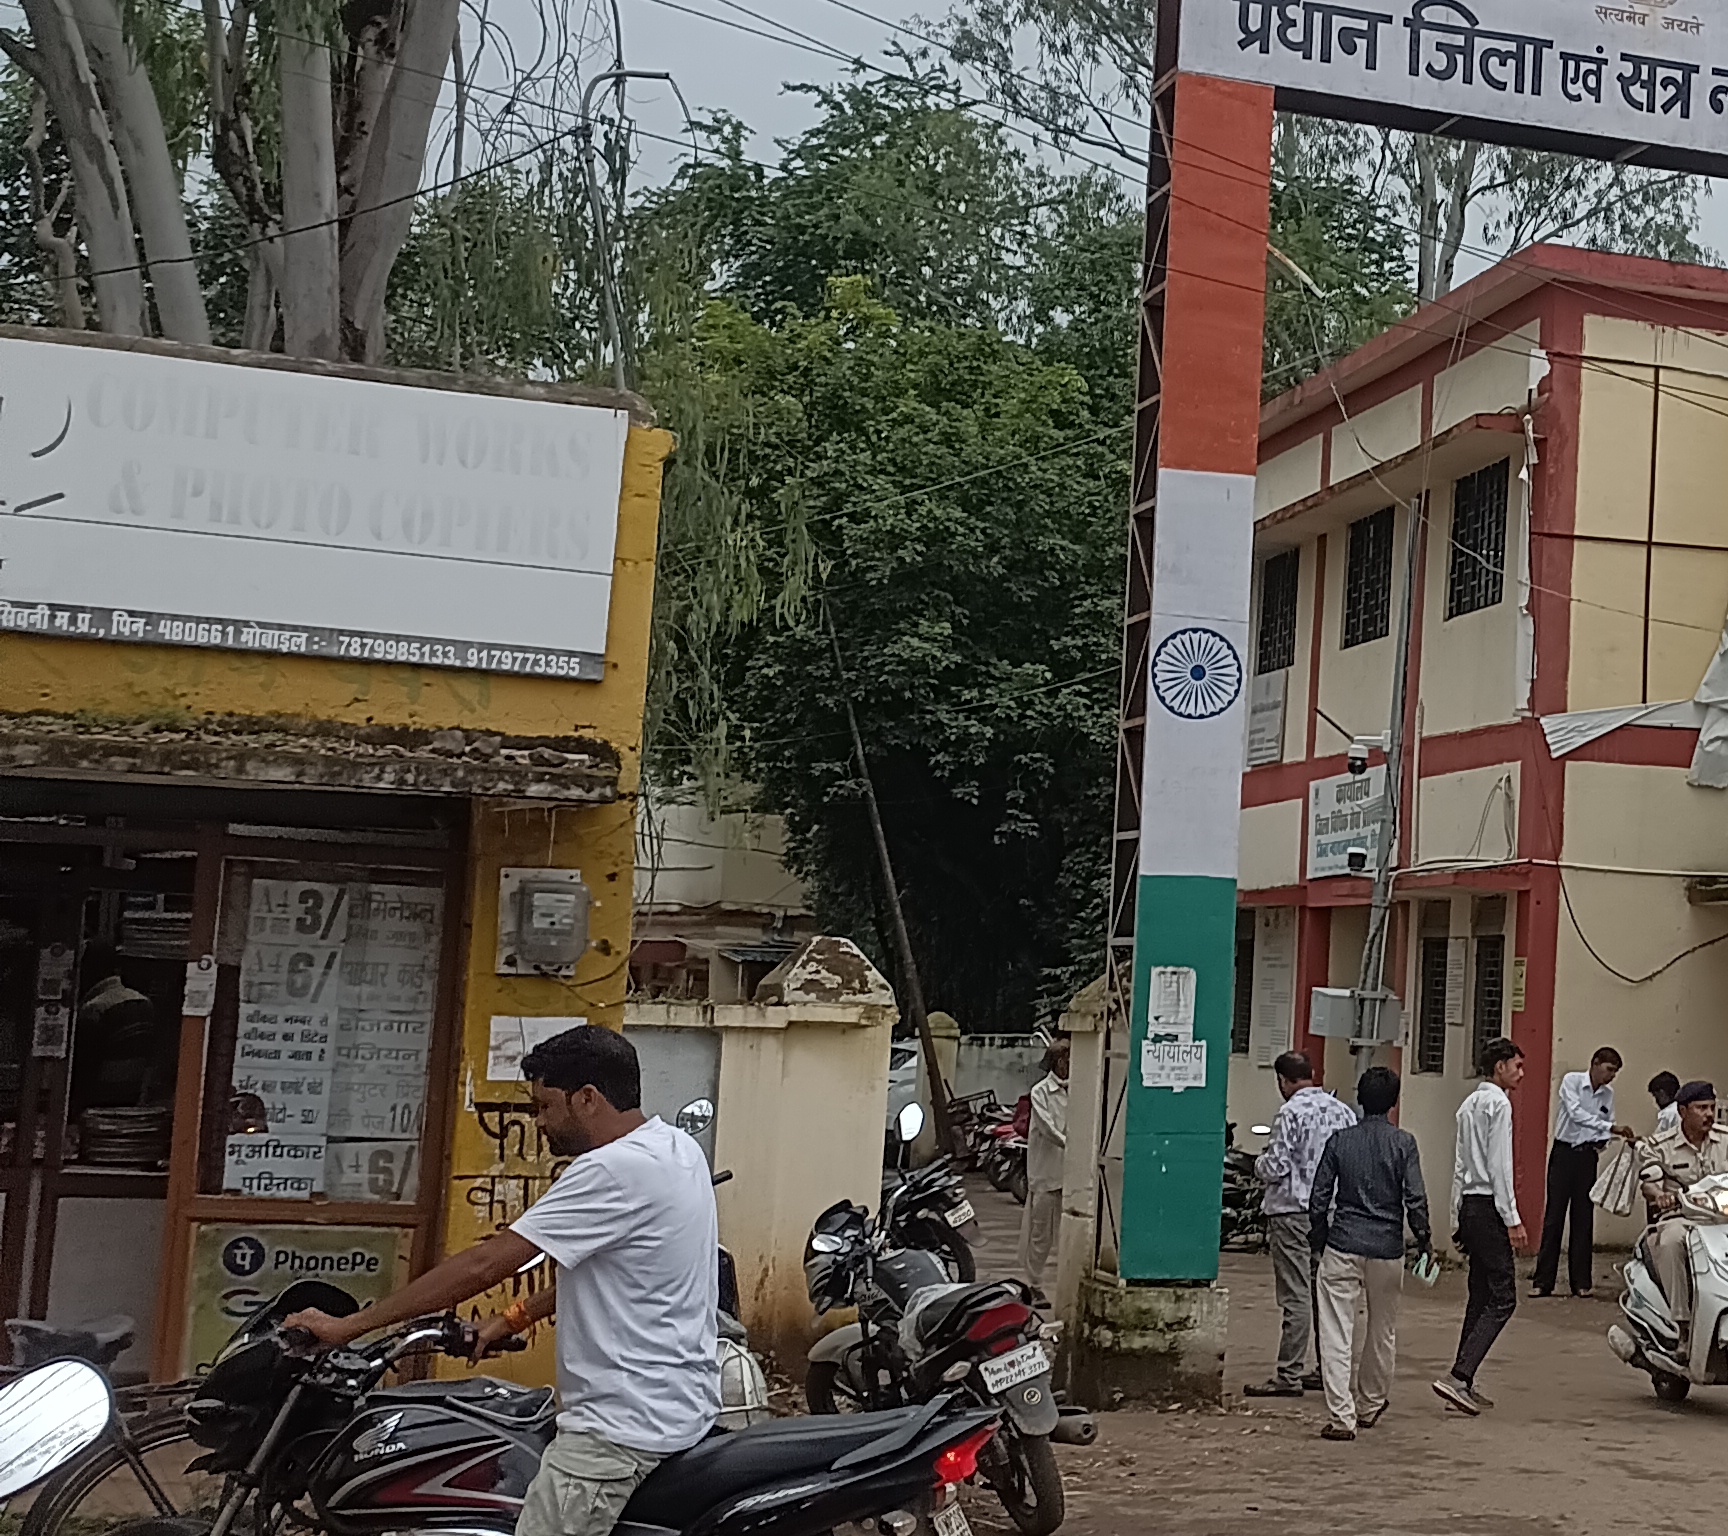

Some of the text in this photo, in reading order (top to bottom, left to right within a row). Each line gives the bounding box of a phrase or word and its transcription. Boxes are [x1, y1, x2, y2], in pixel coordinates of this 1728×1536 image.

[1594, 5, 1706, 36] सत्यमेव जयते
[1559, 45, 1609, 104] एवं
[1616, 52, 1701, 120] सत्र
[416, 412, 592, 481] WORKS
[170, 465, 353, 537] PHOTO
[158, 619, 234, 645] 480661
[240, 622, 308, 652] मोबाइल
[466, 647, 580, 677] 9179773355
[1145, 1043, 1205, 1065] न्यायालय
[273, 1250, 380, 1273] PhonePe
